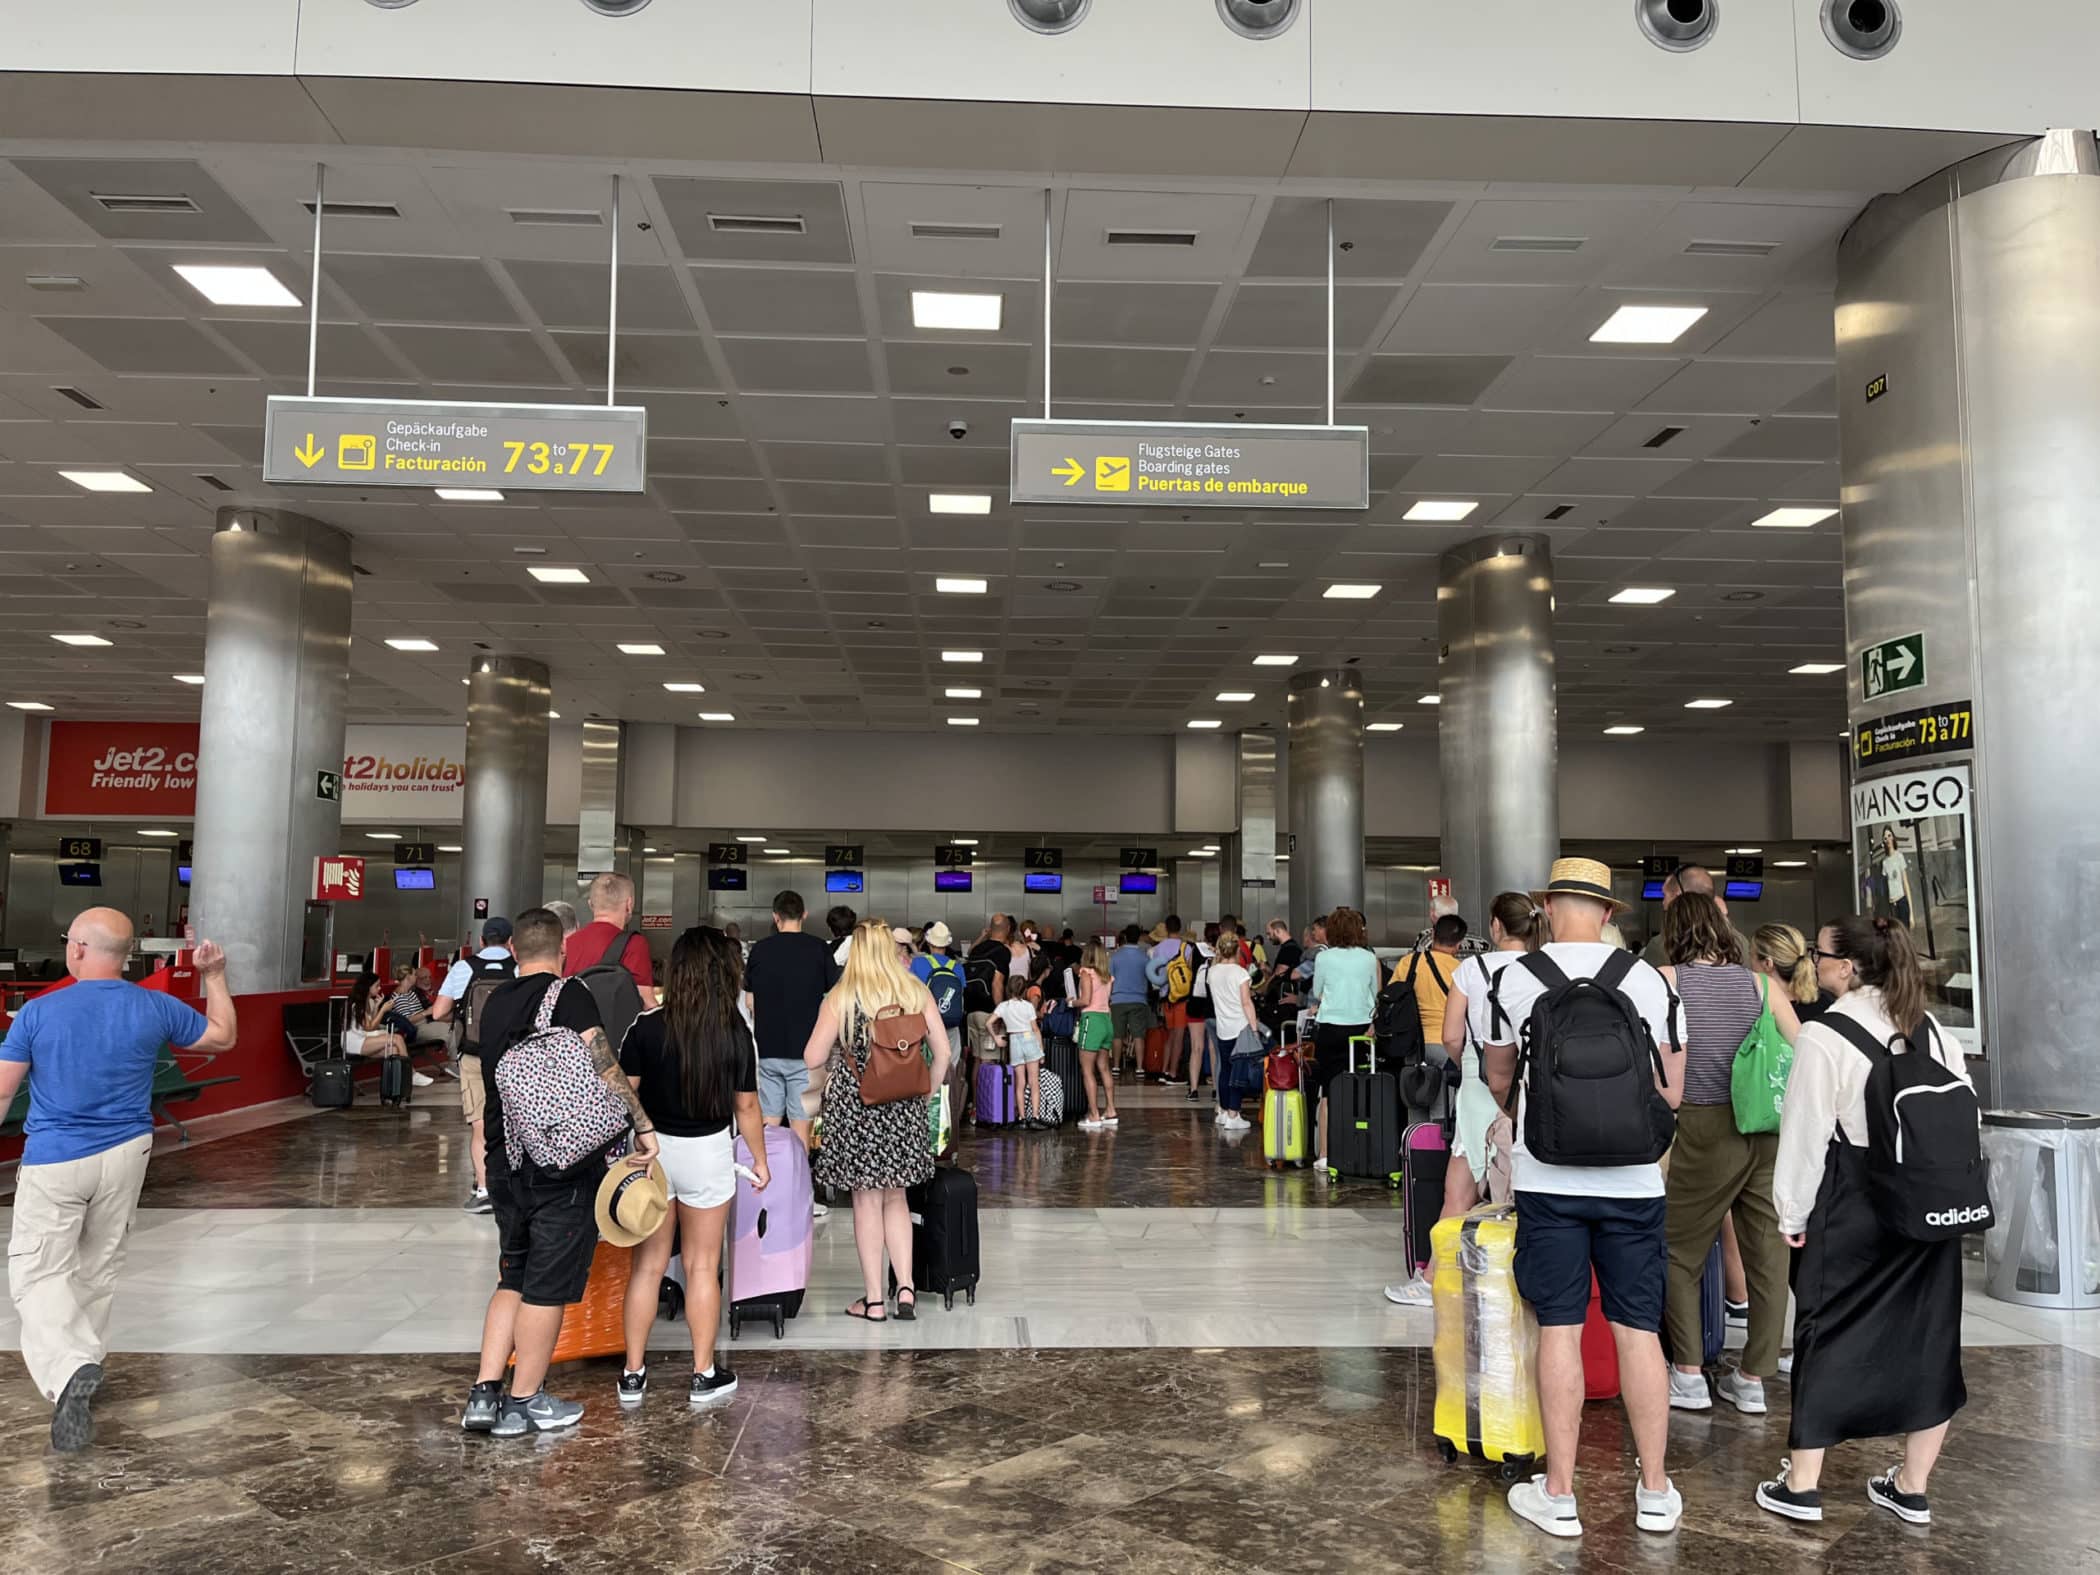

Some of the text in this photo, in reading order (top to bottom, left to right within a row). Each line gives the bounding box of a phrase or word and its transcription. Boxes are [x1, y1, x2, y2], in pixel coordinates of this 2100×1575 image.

[1868, 378, 1884, 397] C07
[386, 420, 488, 438] Gepäckaufgabe
[386, 438, 441, 452] Check-in
[1138, 443, 1240, 459] Flugsteige Gates
[385, 454, 487, 473] Facturación
[503, 441, 615, 476] 73 to 77
[553, 462, 563, 475] a
[1138, 459, 1230, 477] Boarding gates
[1138, 477, 1308, 497] Puertas de embarque
[1919, 711, 1970, 744] 73 to 77
[1940, 728, 1949, 741] a
[93, 746, 199, 772] Jet2.c
[343, 755, 465, 787] t2holiday
[91, 772, 194, 791] Friendly low
[348, 782, 389, 792] holidays
[391, 783, 408, 792] you
[411, 783, 429, 792] can
[431, 783, 455, 792] trust
[1854, 776, 1963, 821] MANGO
[70, 841, 91, 856] 68
[405, 847, 424, 861] 71
[719, 847, 738, 861] 73
[835, 849, 853, 863] 74
[944, 849, 964, 863] 75
[1034, 850, 1053, 865] 76
[1128, 850, 1148, 865] 77
[1925, 1205, 1990, 1226] adidas
